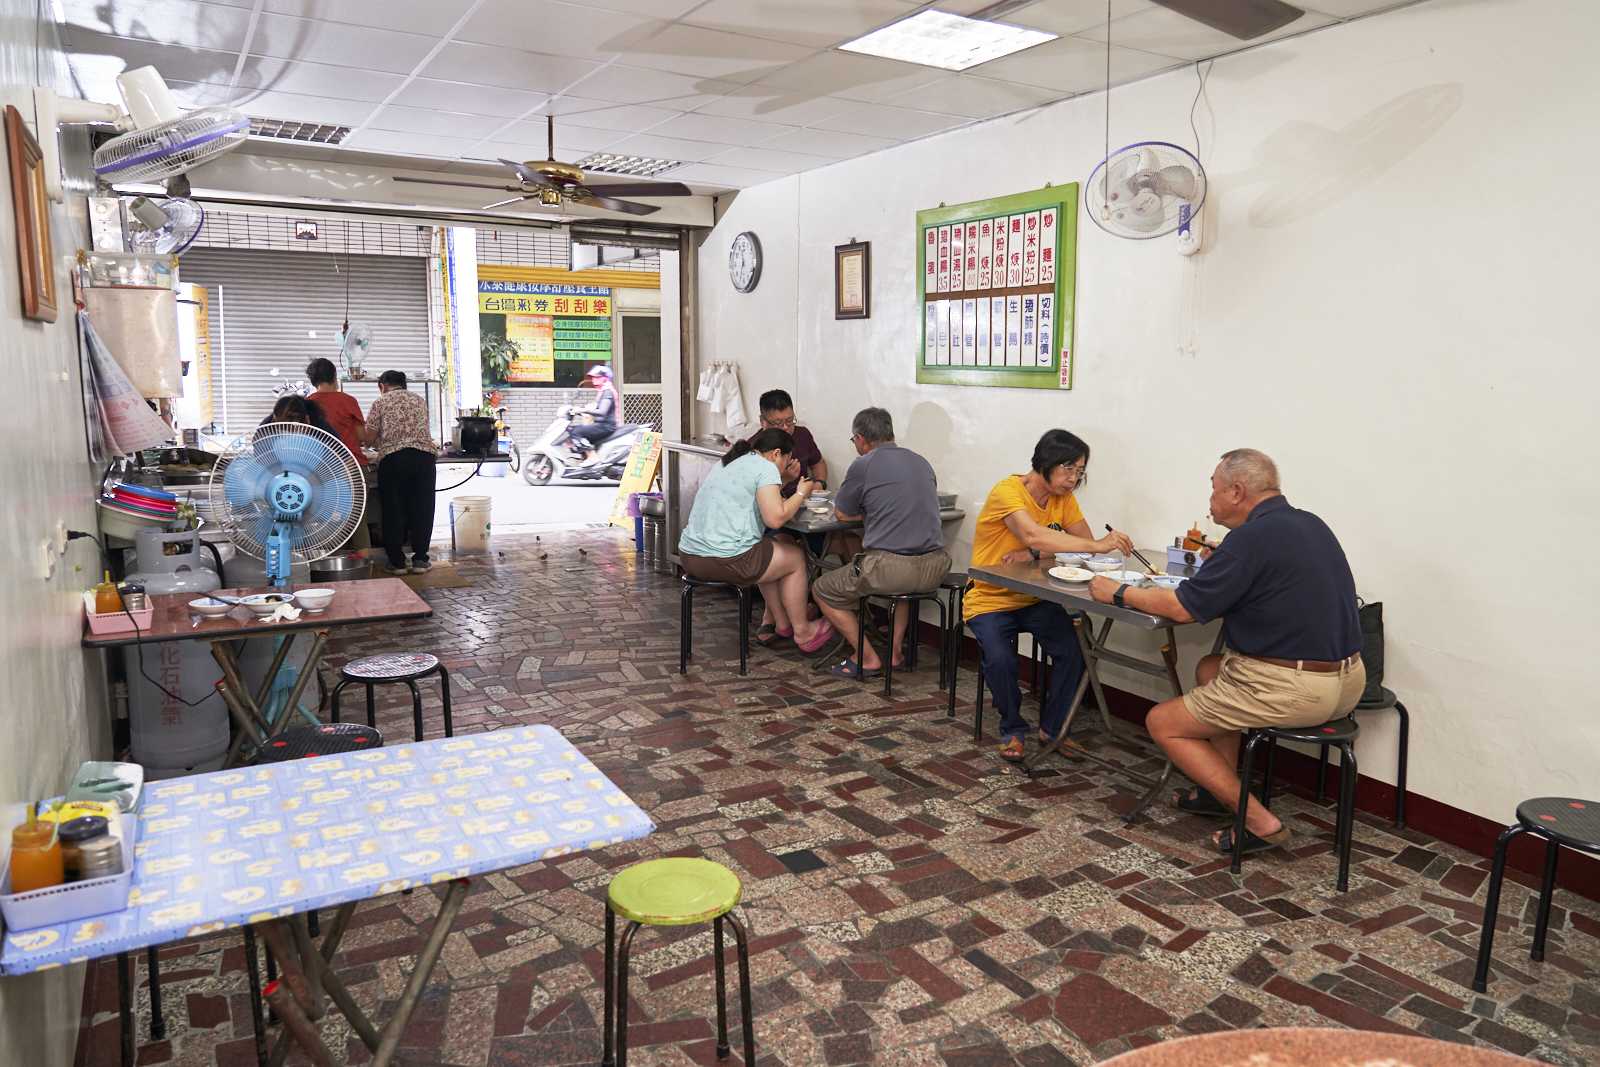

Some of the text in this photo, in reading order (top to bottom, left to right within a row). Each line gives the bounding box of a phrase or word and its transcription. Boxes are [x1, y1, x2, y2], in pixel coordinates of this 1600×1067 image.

[1024, 216, 1036, 282] 炒米粉 25
[966, 274, 976, 286] 40
[980, 271, 990, 286] 25
[994, 270, 1004, 286] 30
[1009, 269, 1020, 284] 30
[1042, 265, 1053, 281] 25
[938, 276, 948, 290] 35
[952, 274, 961, 288] 25
[1009, 300, 1018, 346] 生腸
[158, 641, 183, 726] 化石油氣
